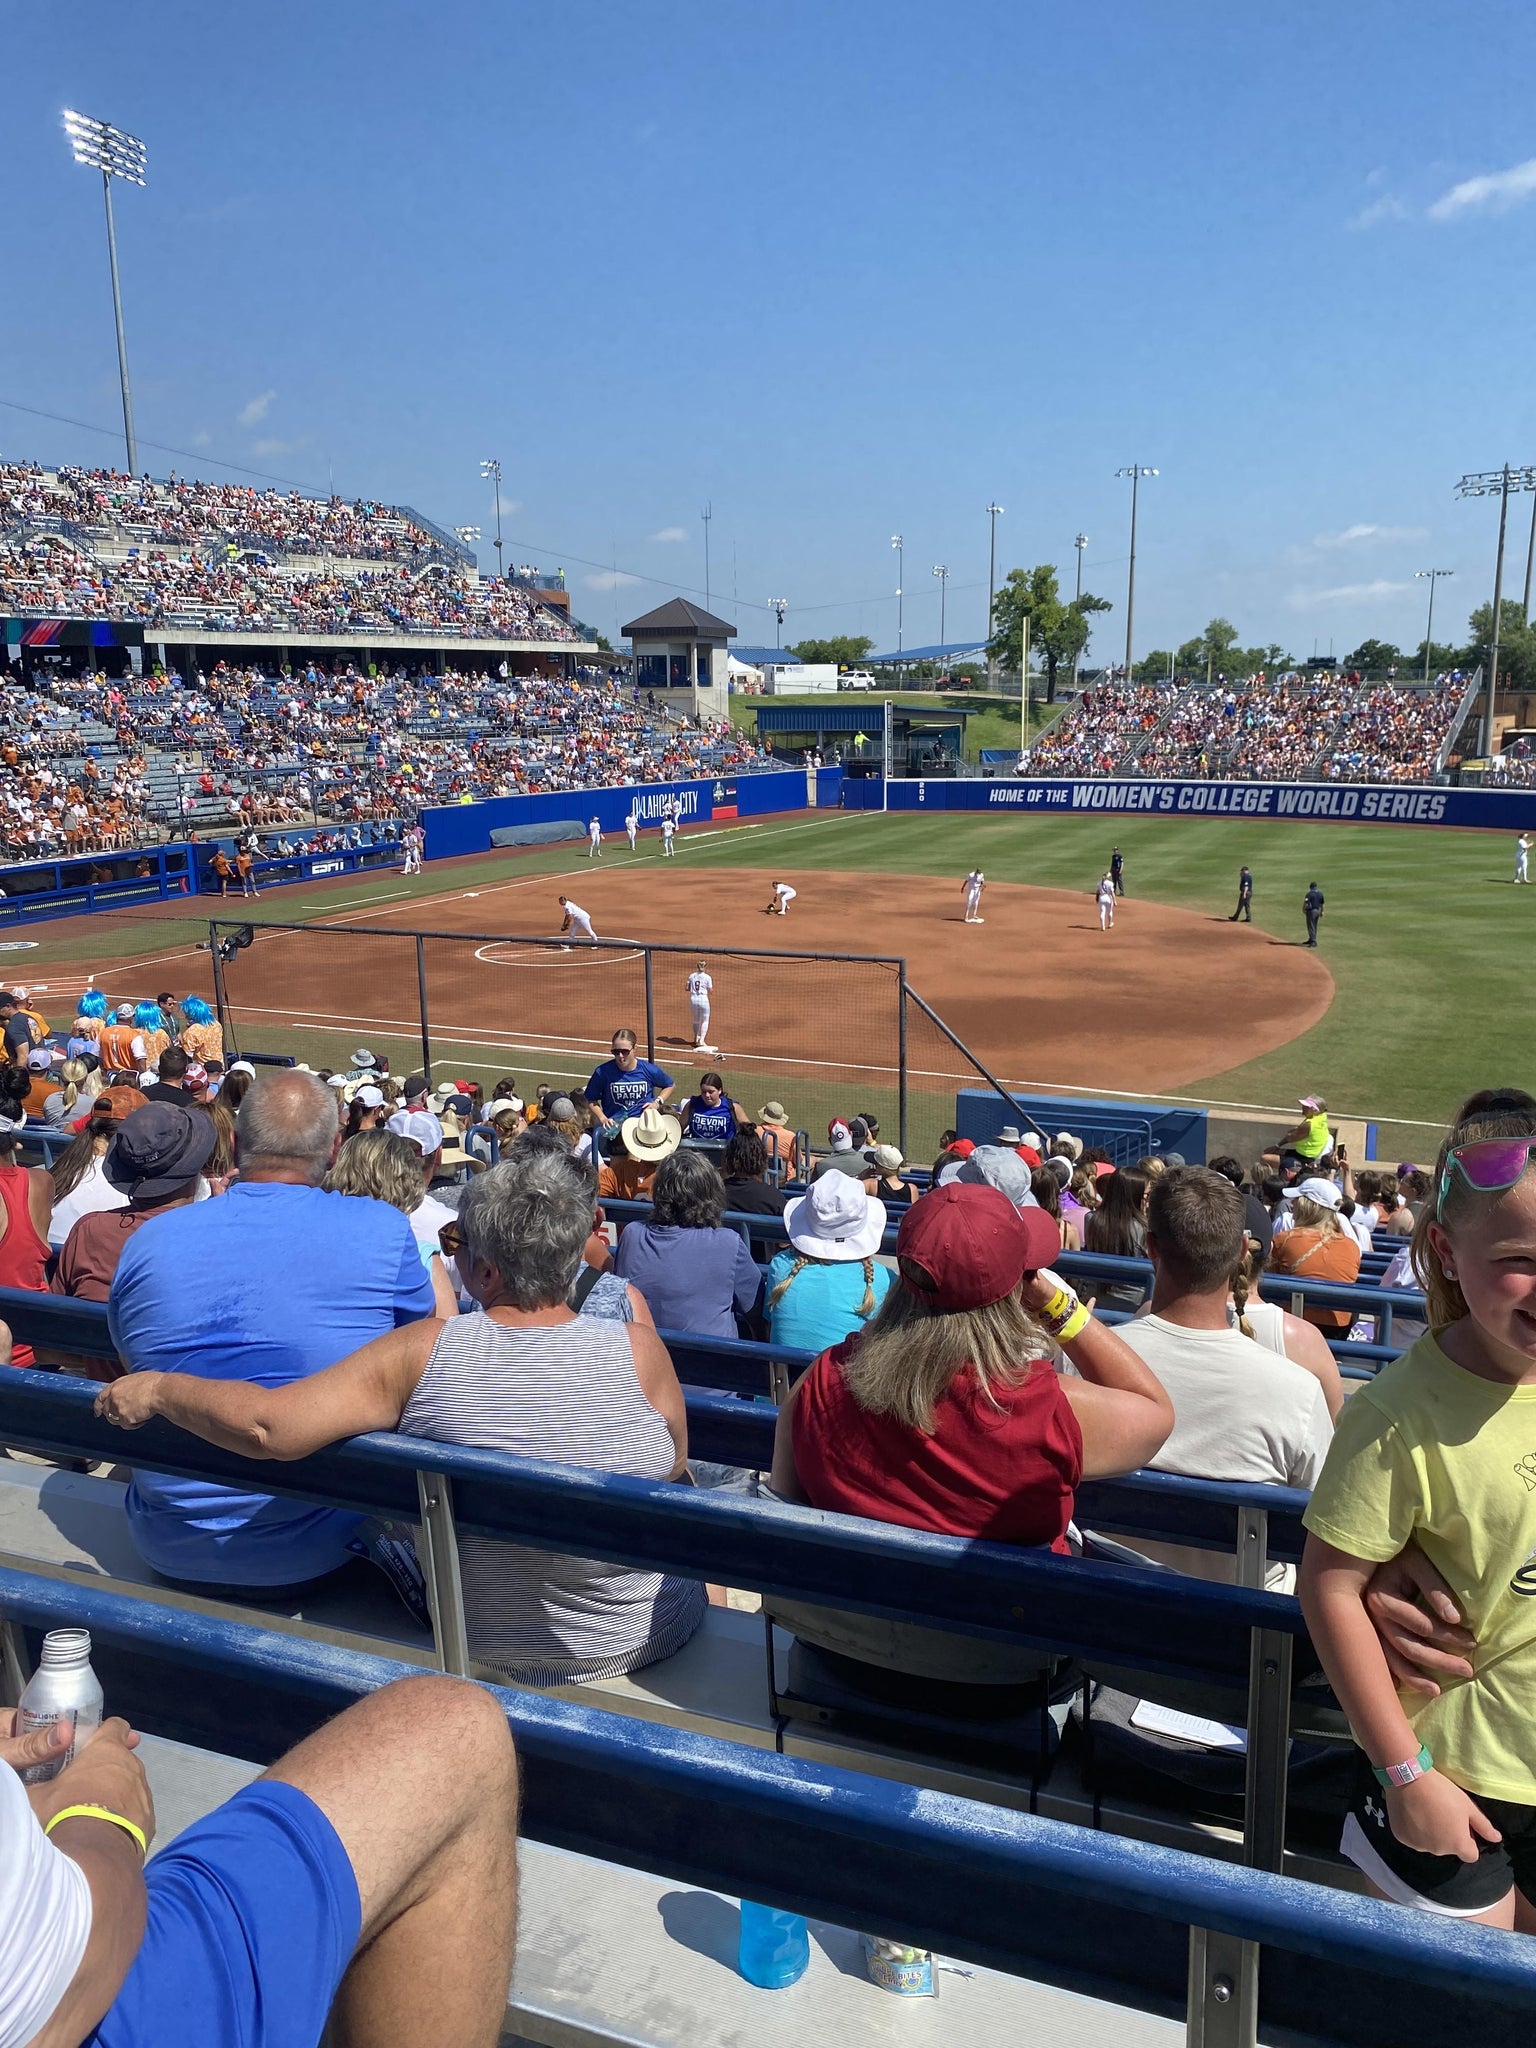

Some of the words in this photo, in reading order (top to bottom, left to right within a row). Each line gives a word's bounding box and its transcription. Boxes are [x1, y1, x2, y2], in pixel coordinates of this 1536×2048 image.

[632, 791, 676, 820] OKLAHO
[680, 790, 699, 815] CITY
[989, 788, 1025, 803] HOME
[1027, 788, 1043, 803] OF
[1046, 789, 1069, 803] THE
[1072, 785, 1175, 810] WOMEN'S
[1177, 786, 1273, 813] COLLEGE
[1276, 789, 1358, 816] WORLD
[1360, 792, 1448, 820] SERIES
[311, 857, 344, 875] ESPN
[612, 1084, 645, 1094] DEVON
[616, 1092, 642, 1100] PARK
[694, 1116, 724, 1127] DEVON
[696, 1124, 720, 1132] PARK
[897, 1971, 922, 1980] BITES
